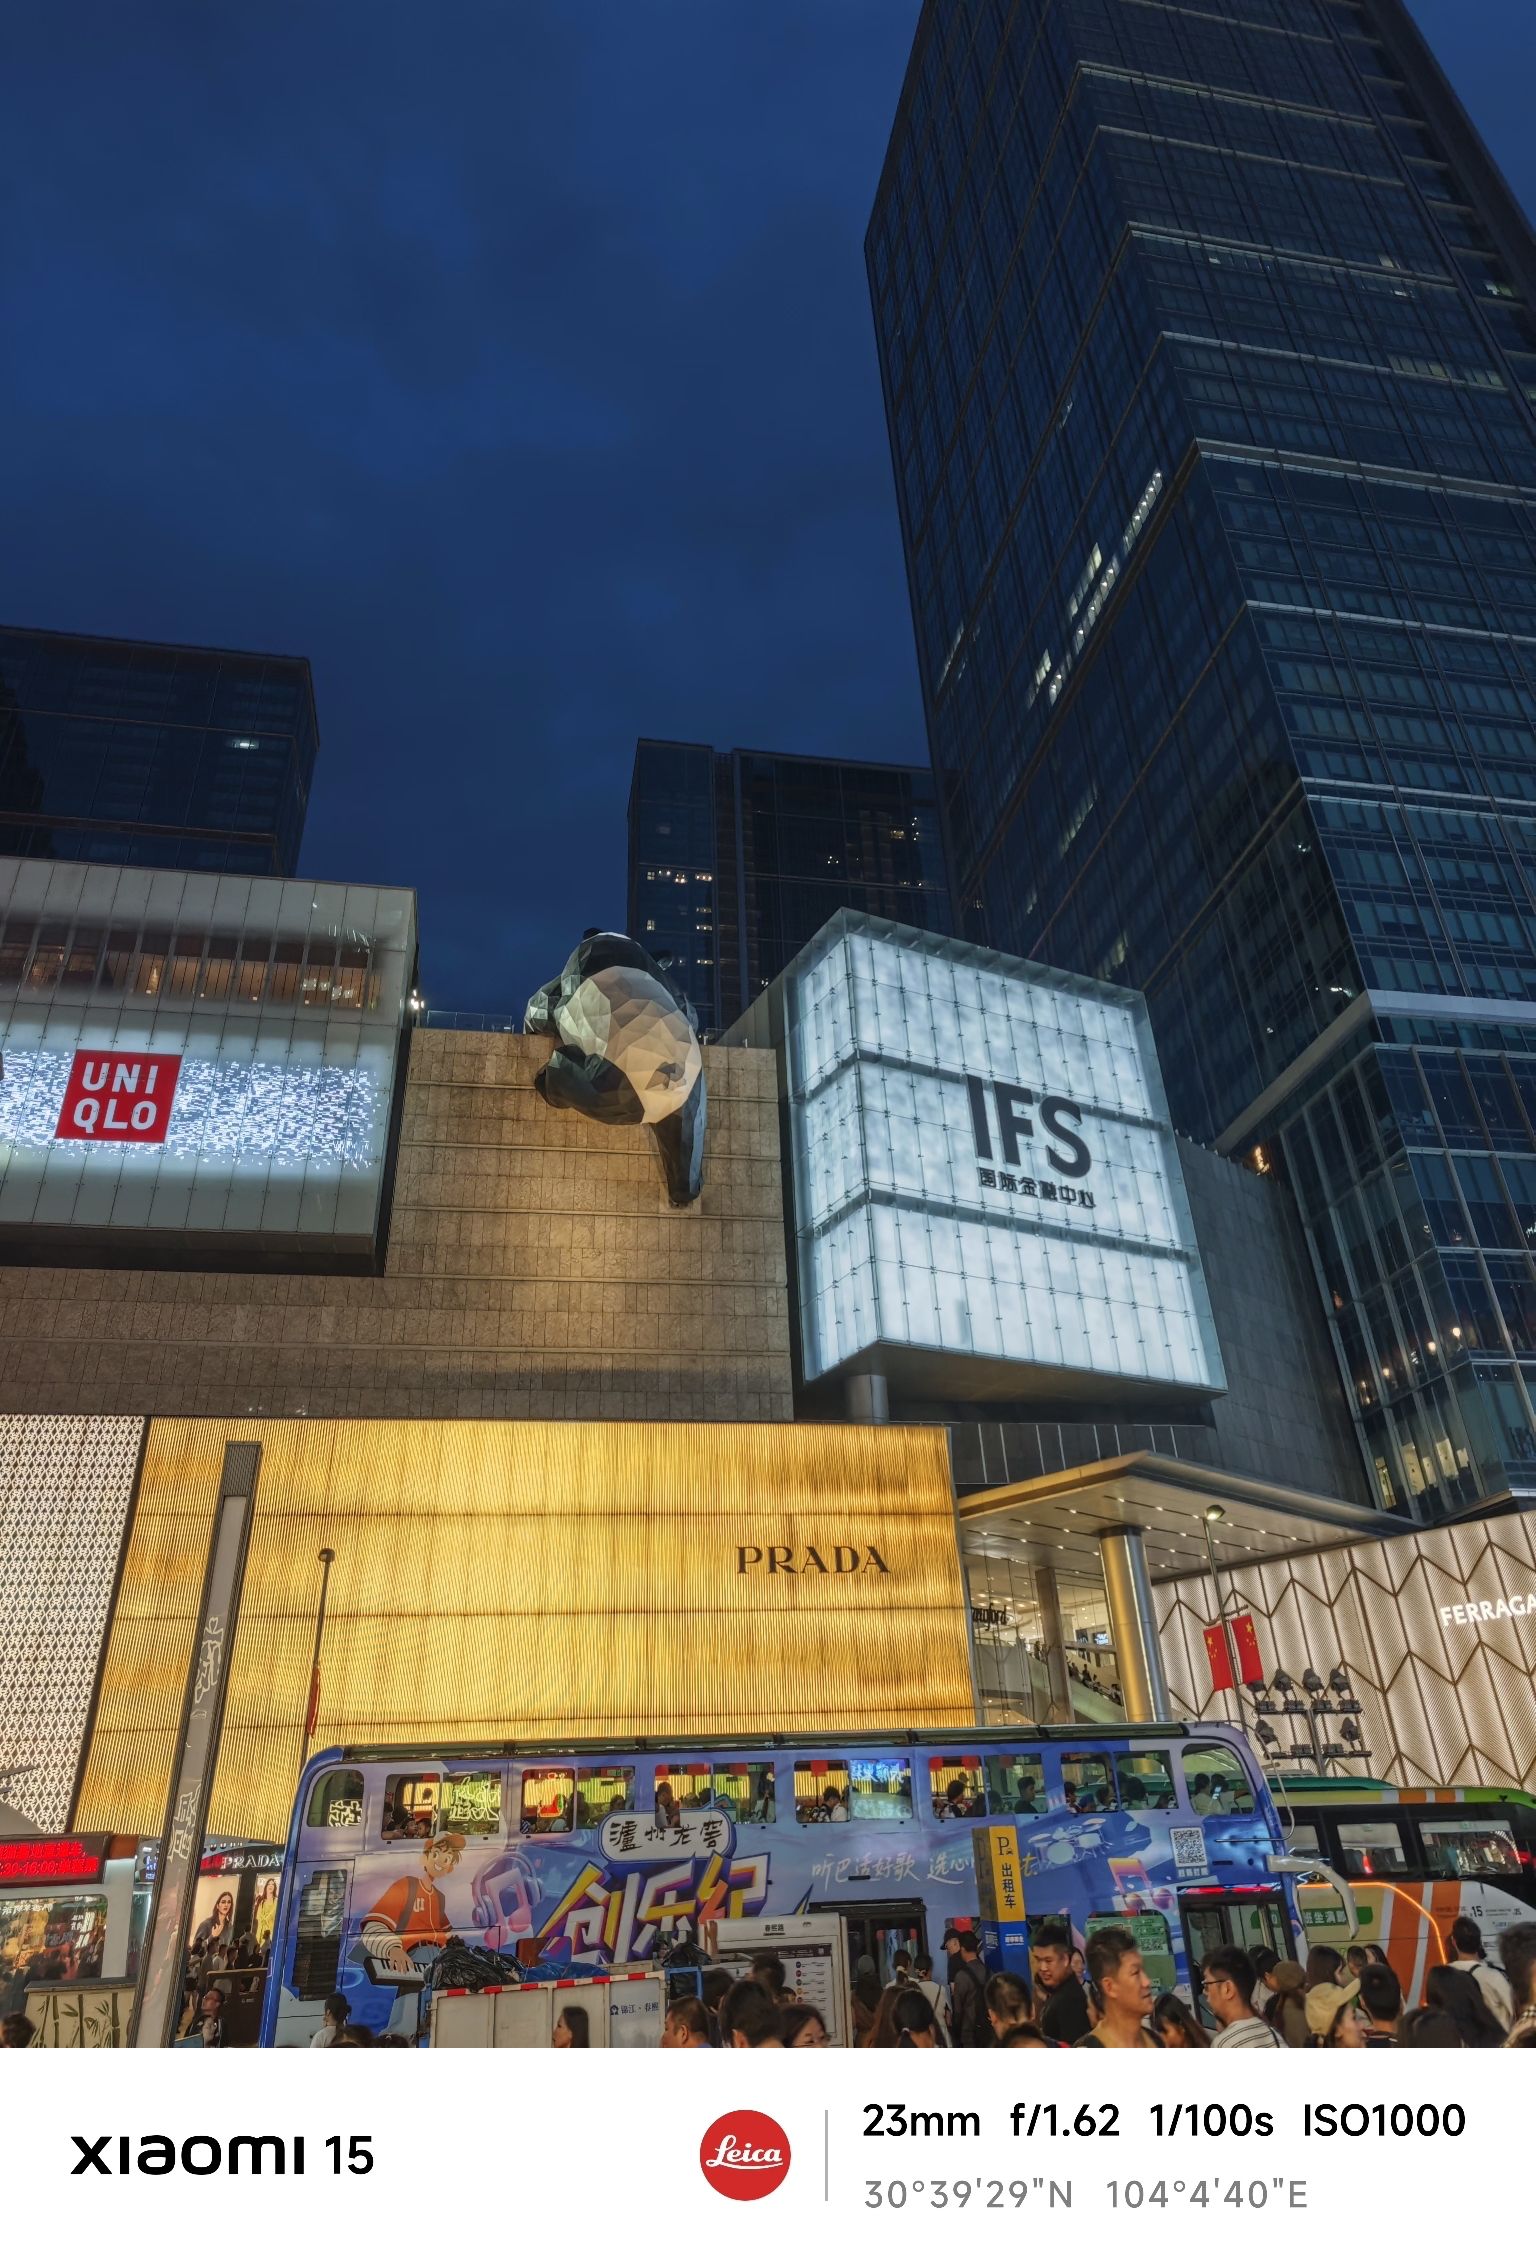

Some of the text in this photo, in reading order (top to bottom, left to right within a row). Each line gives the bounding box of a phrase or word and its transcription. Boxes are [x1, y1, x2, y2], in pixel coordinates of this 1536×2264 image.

[82, 1061, 159, 1094] UNI
[73, 1098, 157, 1134] QLO
[967, 1073, 1091, 1179] IFS
[976, 1166, 1097, 1209] 国际金融中心
[735, 1545, 891, 1574] PRADA
[220, 1854, 281, 1870] PRADA
[996, 1836, 1010, 1856] P
[1001, 1862, 1017, 1909] 出租车
